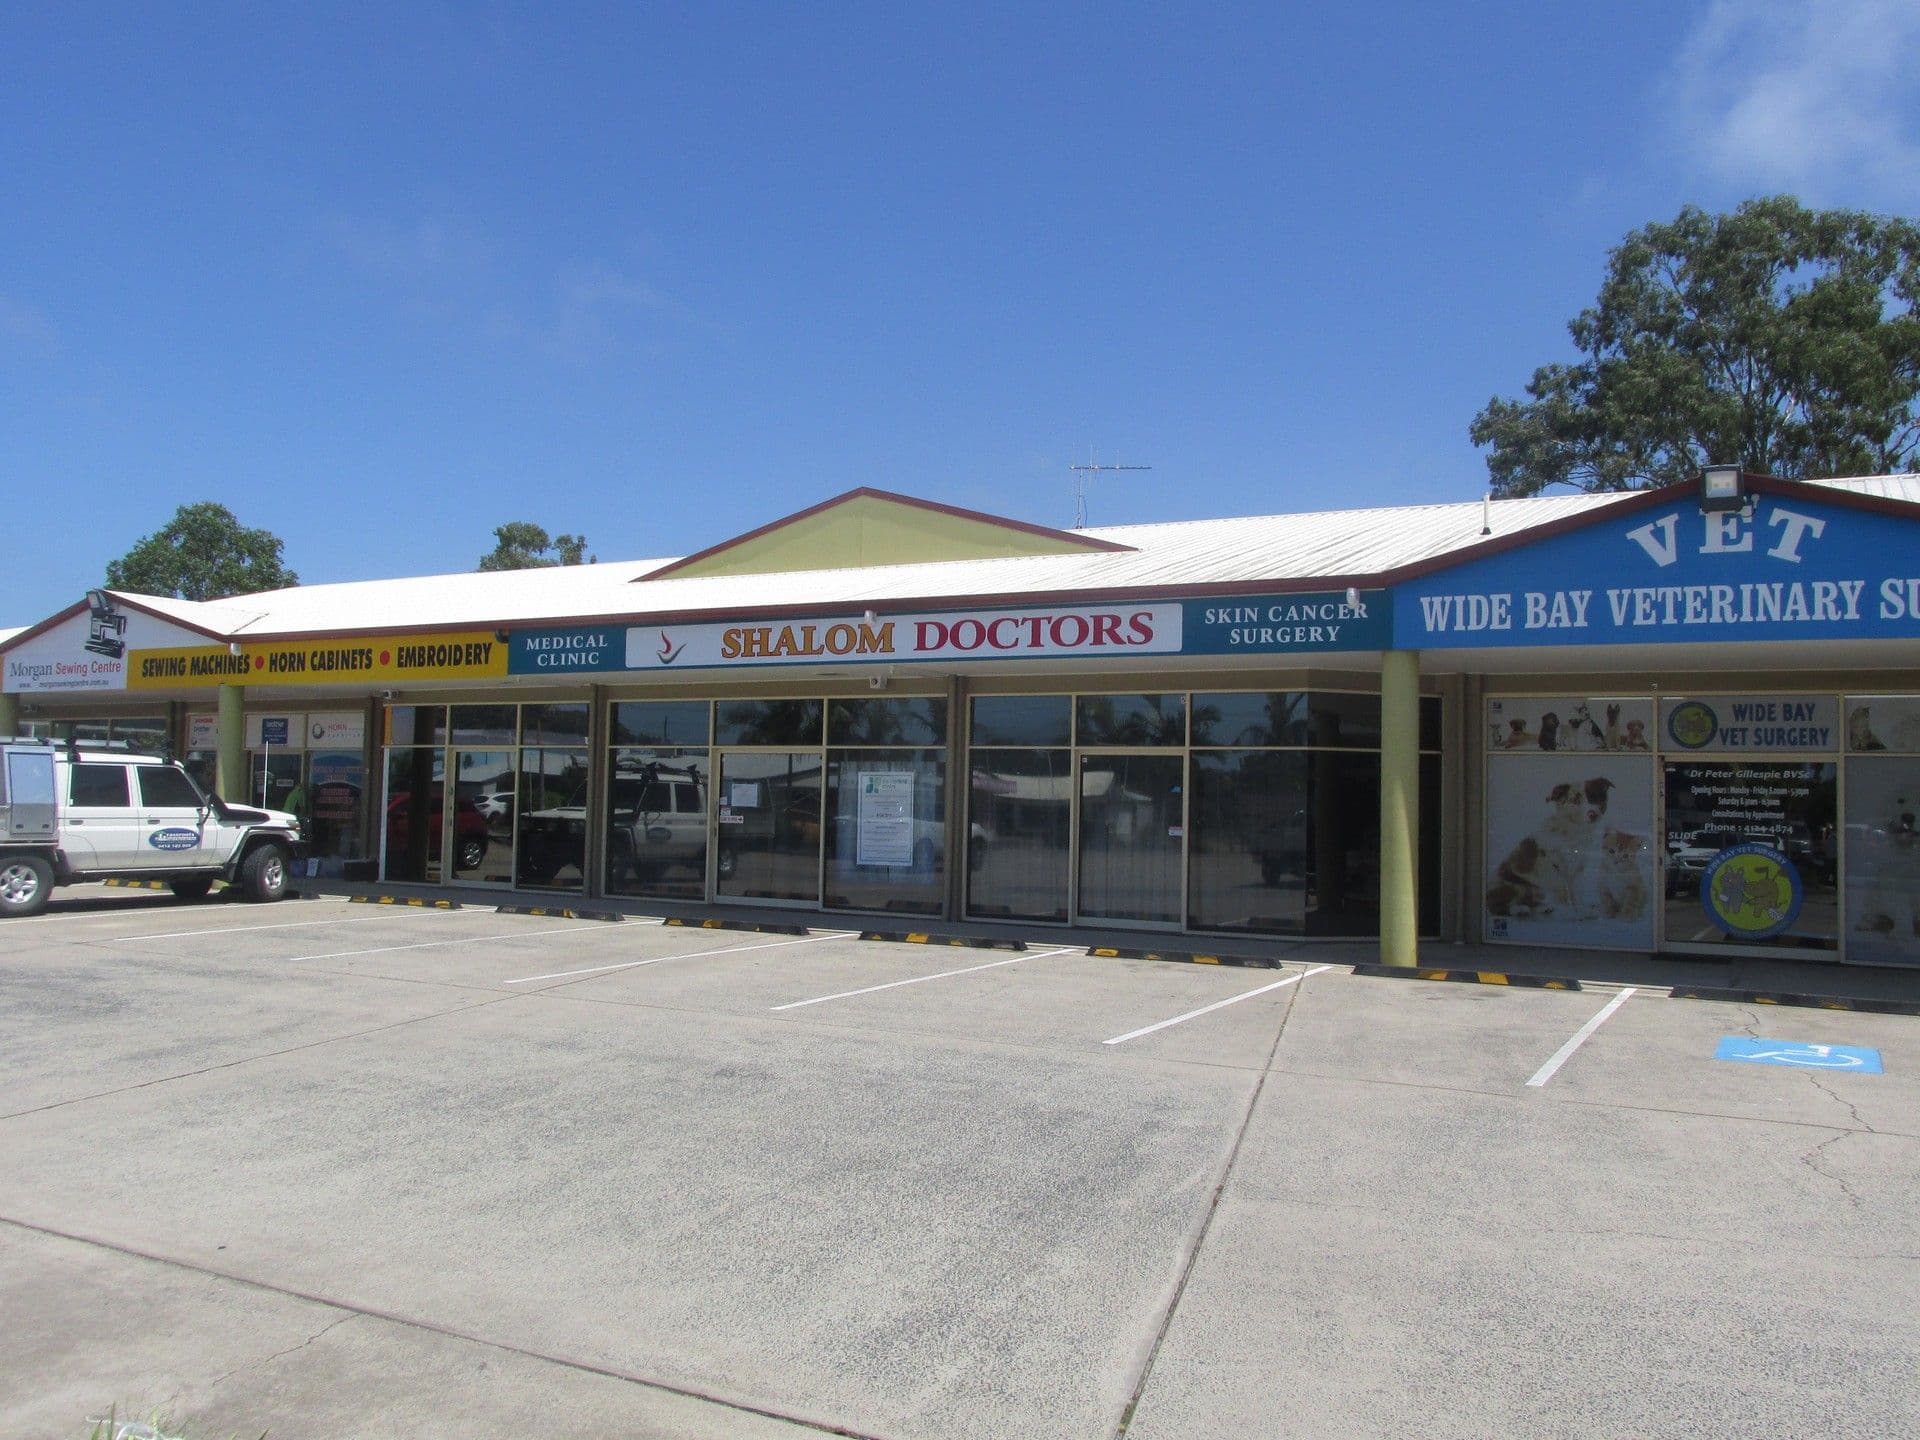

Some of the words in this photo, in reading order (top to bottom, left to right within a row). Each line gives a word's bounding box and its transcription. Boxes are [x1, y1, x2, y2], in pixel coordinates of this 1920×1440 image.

[1625, 507, 1826, 567] VET
[1204, 607, 1258, 624] SKIN
[1278, 602, 1369, 622] CANCER
[1420, 594, 1512, 632] WIDE
[1525, 588, 1592, 629] BAY
[1607, 579, 1865, 626] VETERINARY
[526, 634, 608, 651] MEDICAL
[721, 622, 896, 659] SHALOM
[913, 611, 1153, 651] DOCTORS
[1229, 625, 1342, 644] SURGERY
[142, 656, 186, 678] SEWING
[190, 653, 250, 677] MACHINES
[269, 650, 305, 673] HORN
[310, 648, 373, 672] CABINETS
[397, 642, 493, 668] EMBROIDERY
[537, 652, 600, 666] CLINIC
[9, 662, 52, 681] Morgan
[55, 662, 88, 677] Sewing
[91, 660, 121, 673] Centre
[1732, 703, 1777, 722] WIDE
[1783, 703, 1816, 722] BAY
[1719, 727, 1748, 746] VET
[1753, 727, 1830, 746] SURGERY
[1690, 769, 1703, 778] Dr
[1705, 770, 1734, 779] Peter
[1735, 770, 1782, 780] Gillespie
[1783, 770, 1811, 779] BVSc
[1669, 832, 1697, 840] SLIDE
[1704, 823, 1736, 832] Phone
